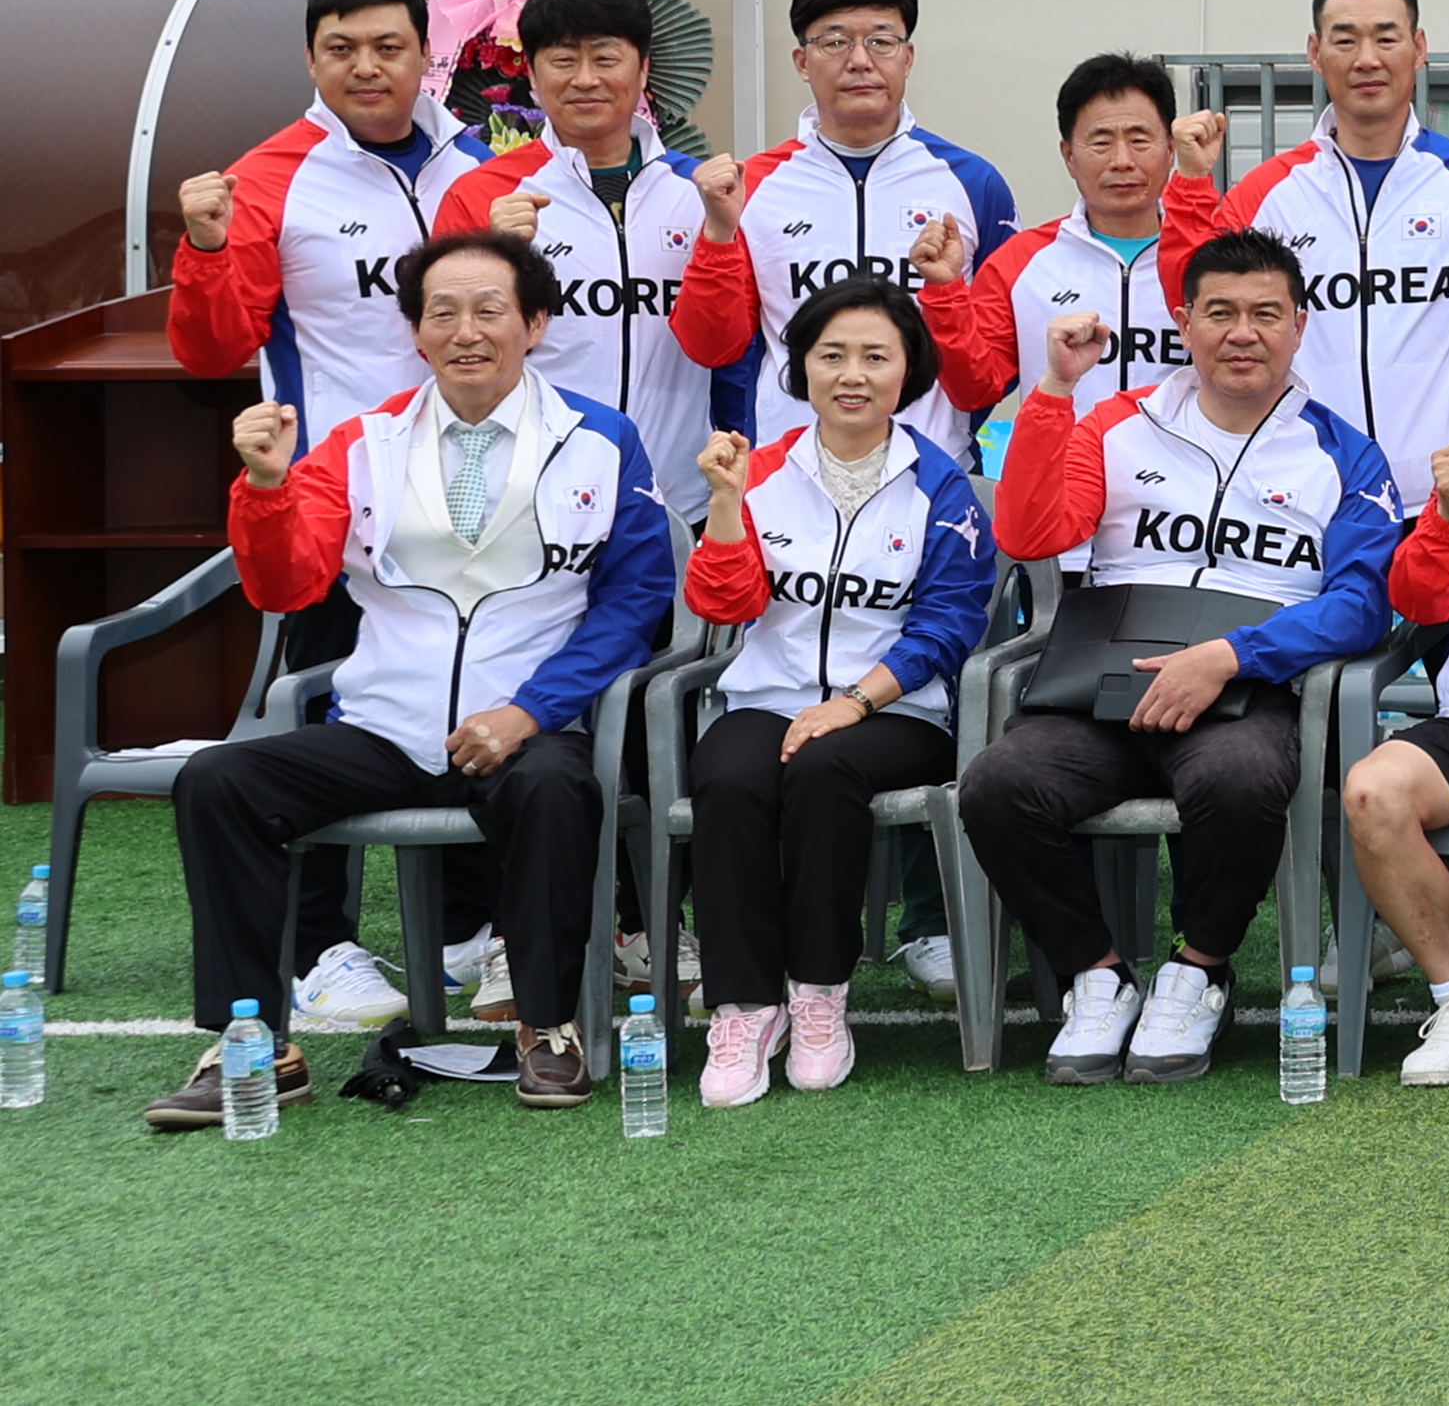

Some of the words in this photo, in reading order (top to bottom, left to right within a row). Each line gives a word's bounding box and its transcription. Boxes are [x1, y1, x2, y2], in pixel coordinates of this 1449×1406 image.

[555, 278, 680, 318] KORE
[790, 255, 918, 299] KORE
[1096, 328, 1193, 365] ORE
[1134, 508, 1322, 572] KOREA
[768, 569, 916, 611] KOREA
